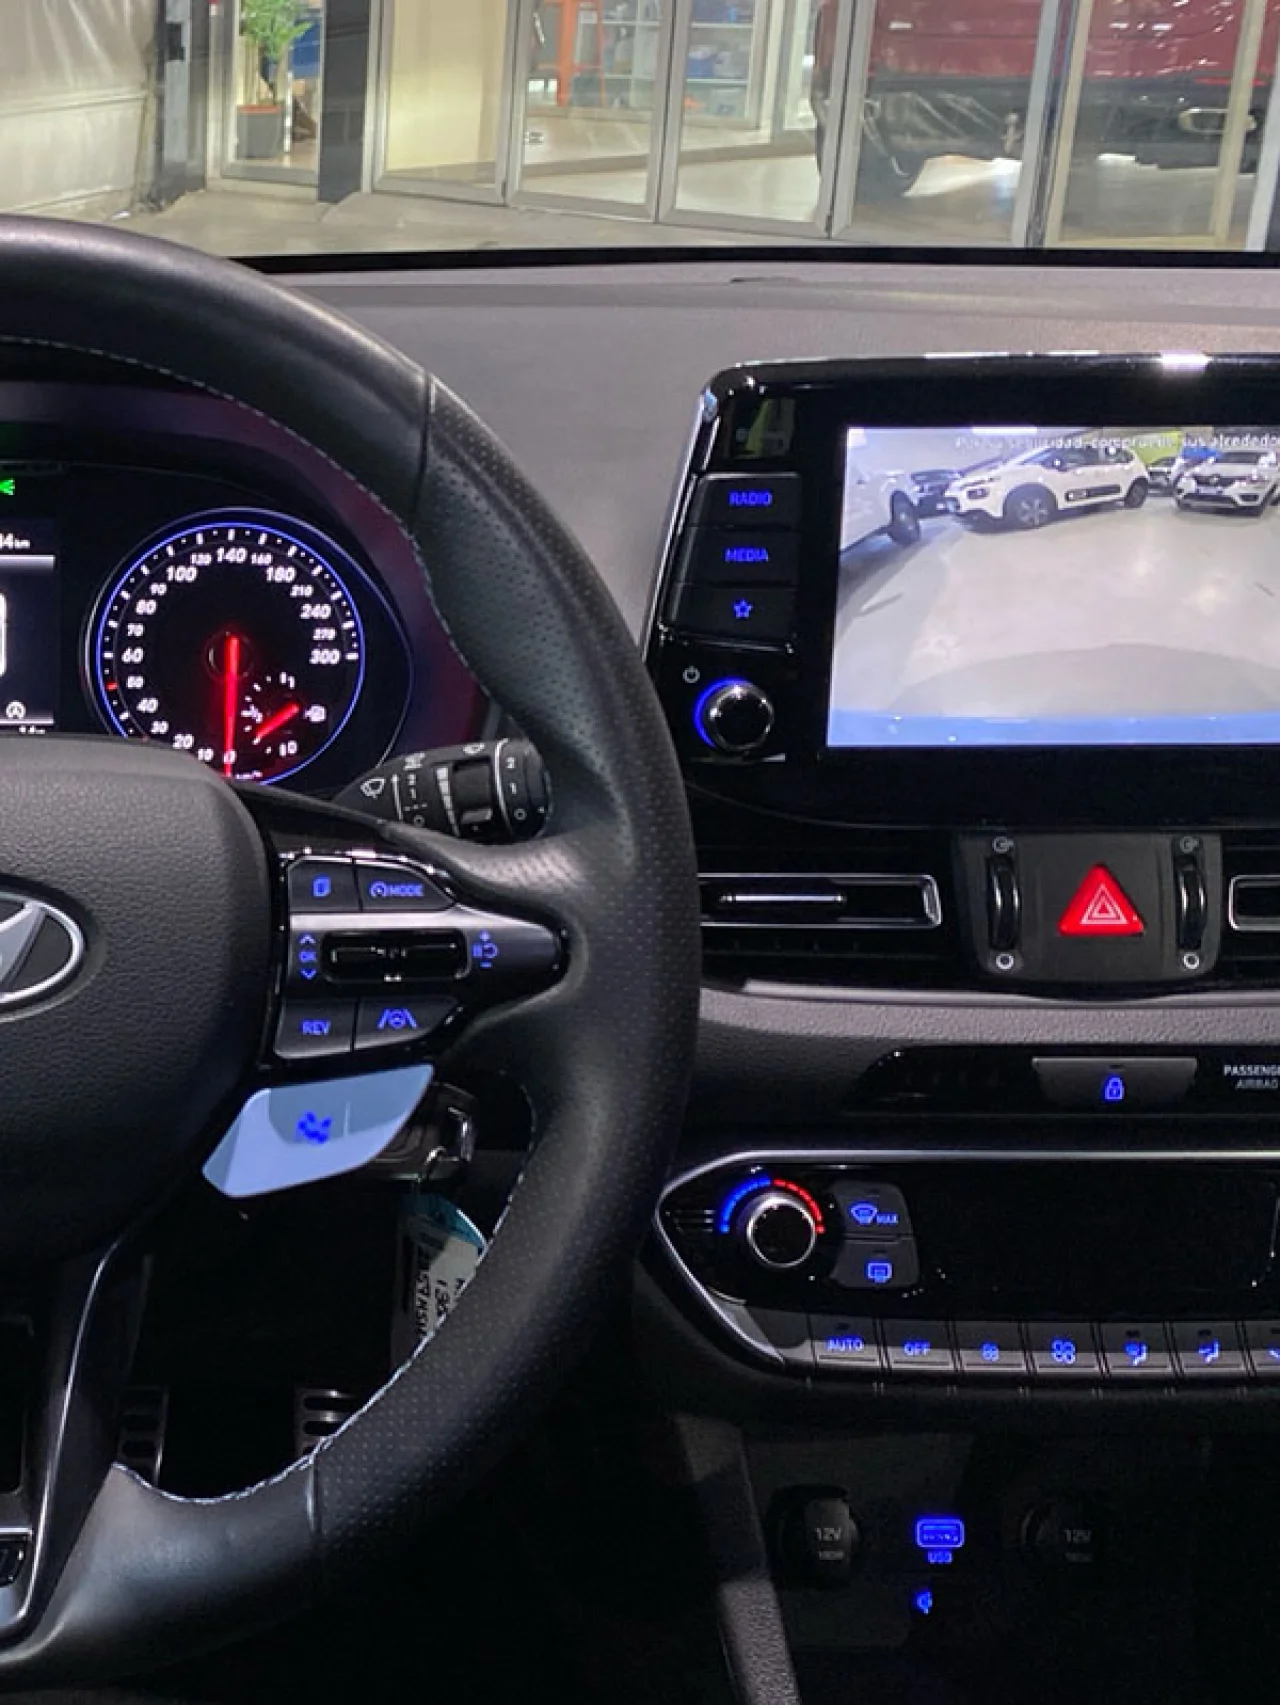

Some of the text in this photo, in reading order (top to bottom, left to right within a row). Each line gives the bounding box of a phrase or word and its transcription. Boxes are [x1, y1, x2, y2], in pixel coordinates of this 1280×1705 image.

[729, 491, 773, 507] RADIO
[217, 547, 248, 564] 140
[724, 547, 769, 562] MEDIA
[166, 566, 198, 582] 100
[266, 566, 297, 582] 180
[150, 582, 167, 597] 90
[289, 584, 314, 598] 210
[135, 600, 157, 616] 80
[300, 603, 332, 619] 240
[127, 623, 144, 637] 70
[121, 646, 144, 664] 60
[309, 648, 341, 665] 300
[136, 697, 159, 714] 40
[172, 733, 195, 750] 20
[197, 748, 214, 762] 10
[389, 884, 424, 897] MODE
[301, 1020, 331, 1036] REV
[876, 1214, 899, 1224] MAX
[827, 1337, 864, 1351] AUTO
[903, 1342, 931, 1356] OFF
